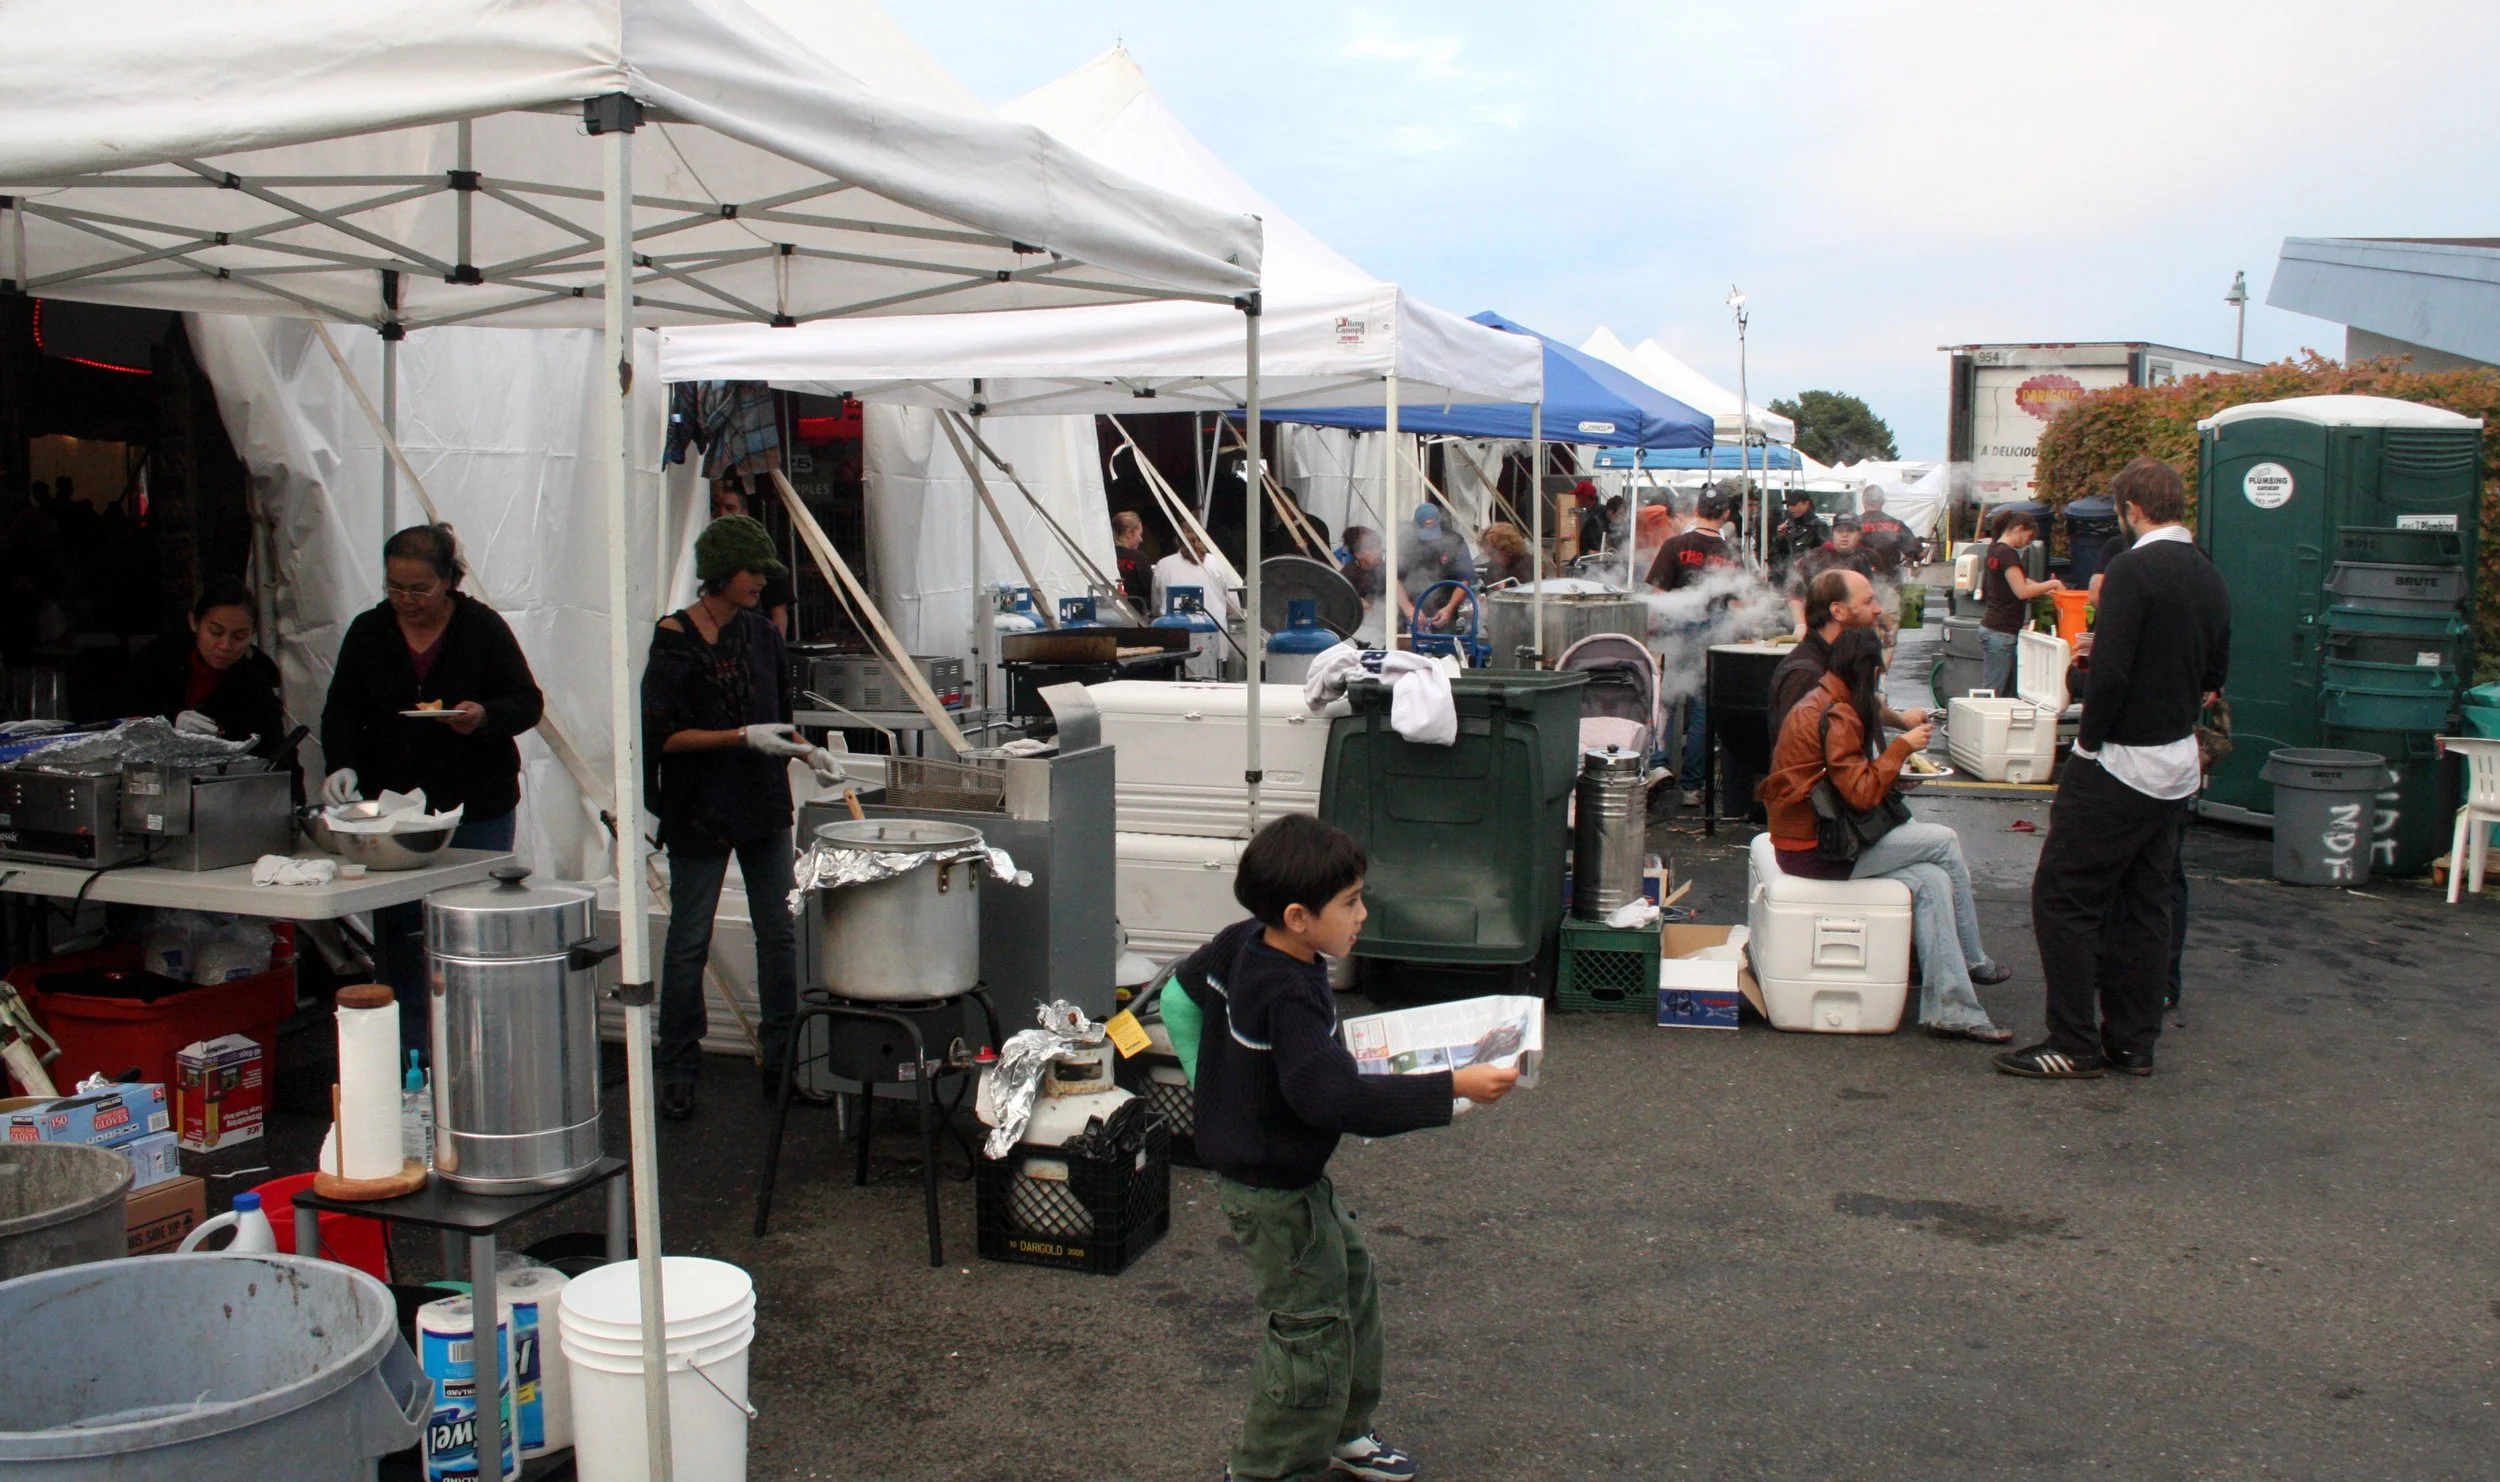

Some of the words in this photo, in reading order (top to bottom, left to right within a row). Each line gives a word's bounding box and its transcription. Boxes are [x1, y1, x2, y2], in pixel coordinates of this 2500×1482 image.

[1979, 352, 1999, 362] 954
[1980, 446, 1988, 457] A
[1992, 446, 2038, 457] DELICIOU
[2248, 477, 2288, 485] PLUMBING
[2395, 576, 2439, 587] BRUTE
[2311, 770, 2343, 779] BRUTE
[154, 1089, 162, 1098] S
[51, 1116, 68, 1128] 150
[95, 1113, 129, 1130] GLOVES
[246, 1124, 262, 1136] ACE
[10, 1133, 39, 1142] GLOVES
[127, 1234, 143, 1249] HIS
[168, 1220, 180, 1234] UP
[1020, 1240, 1063, 1256] DARIGOLD
